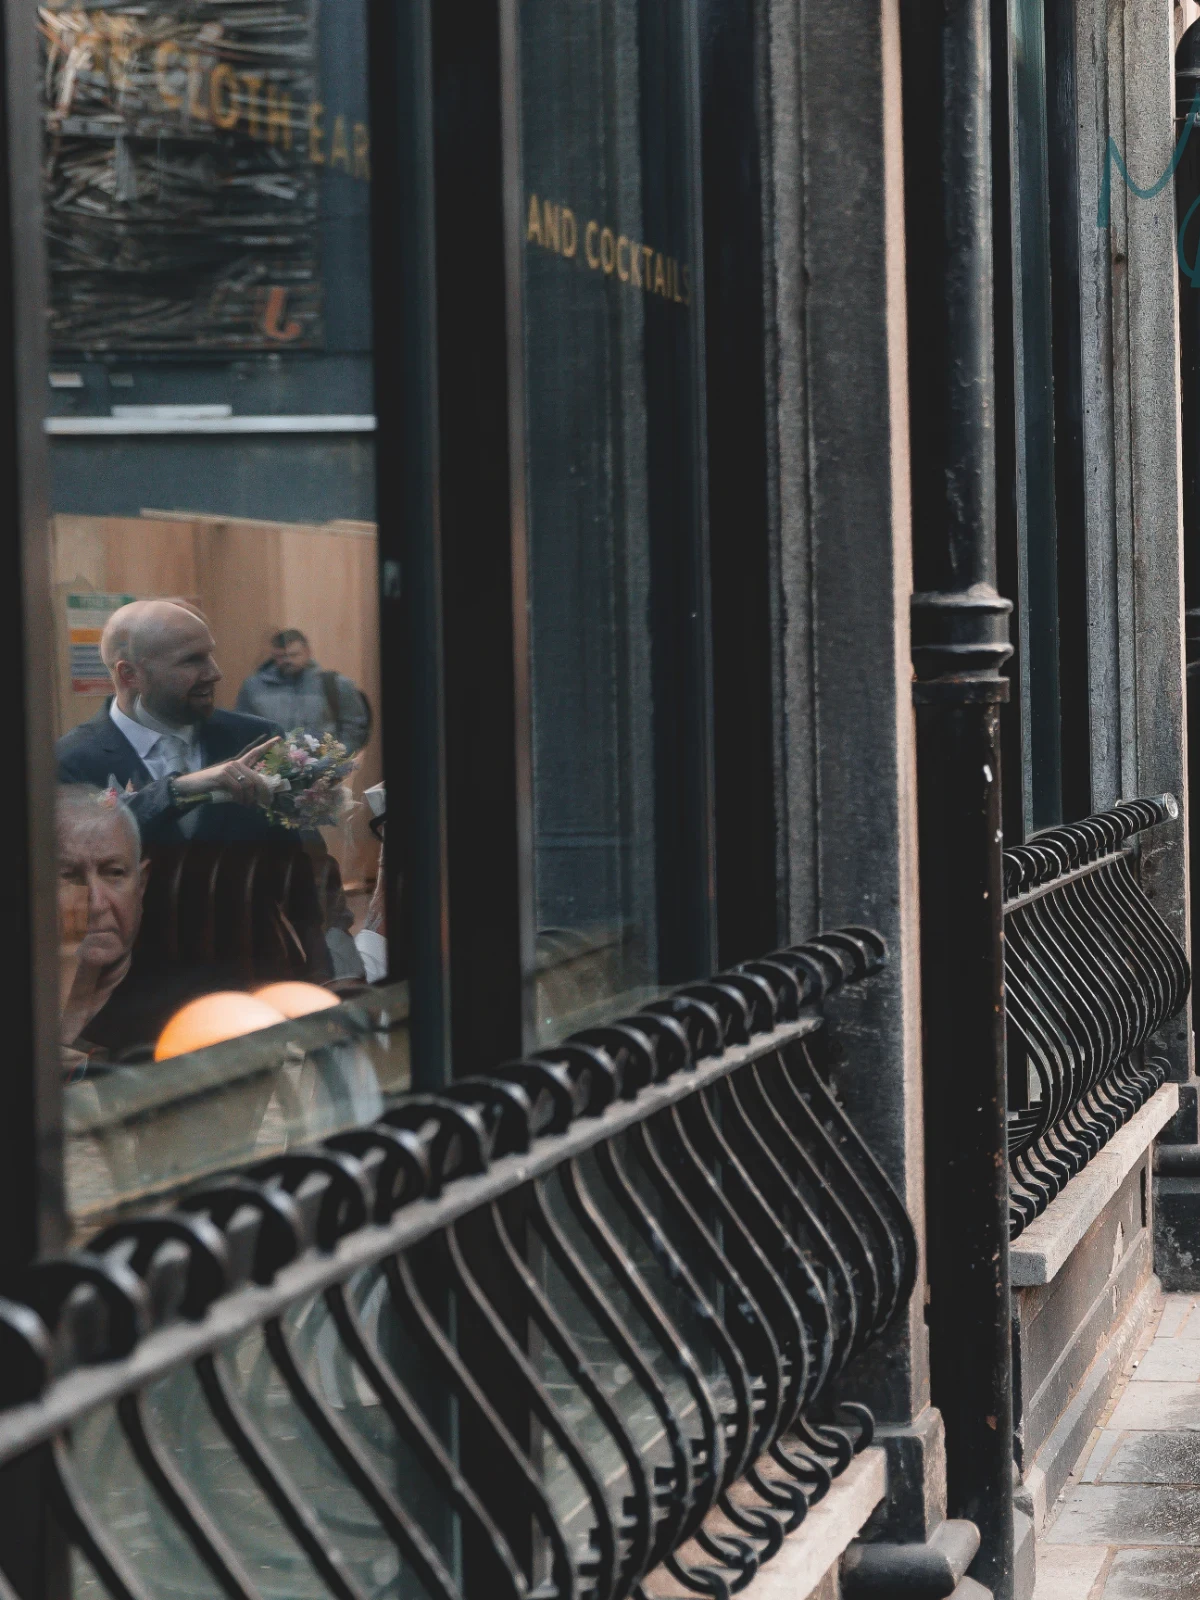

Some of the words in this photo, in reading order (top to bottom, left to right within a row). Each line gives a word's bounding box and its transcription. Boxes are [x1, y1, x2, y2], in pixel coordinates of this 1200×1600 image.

[158, 40, 293, 151] CLOTH
[307, 100, 372, 181] EAR
[528, 193, 577, 258] AND
